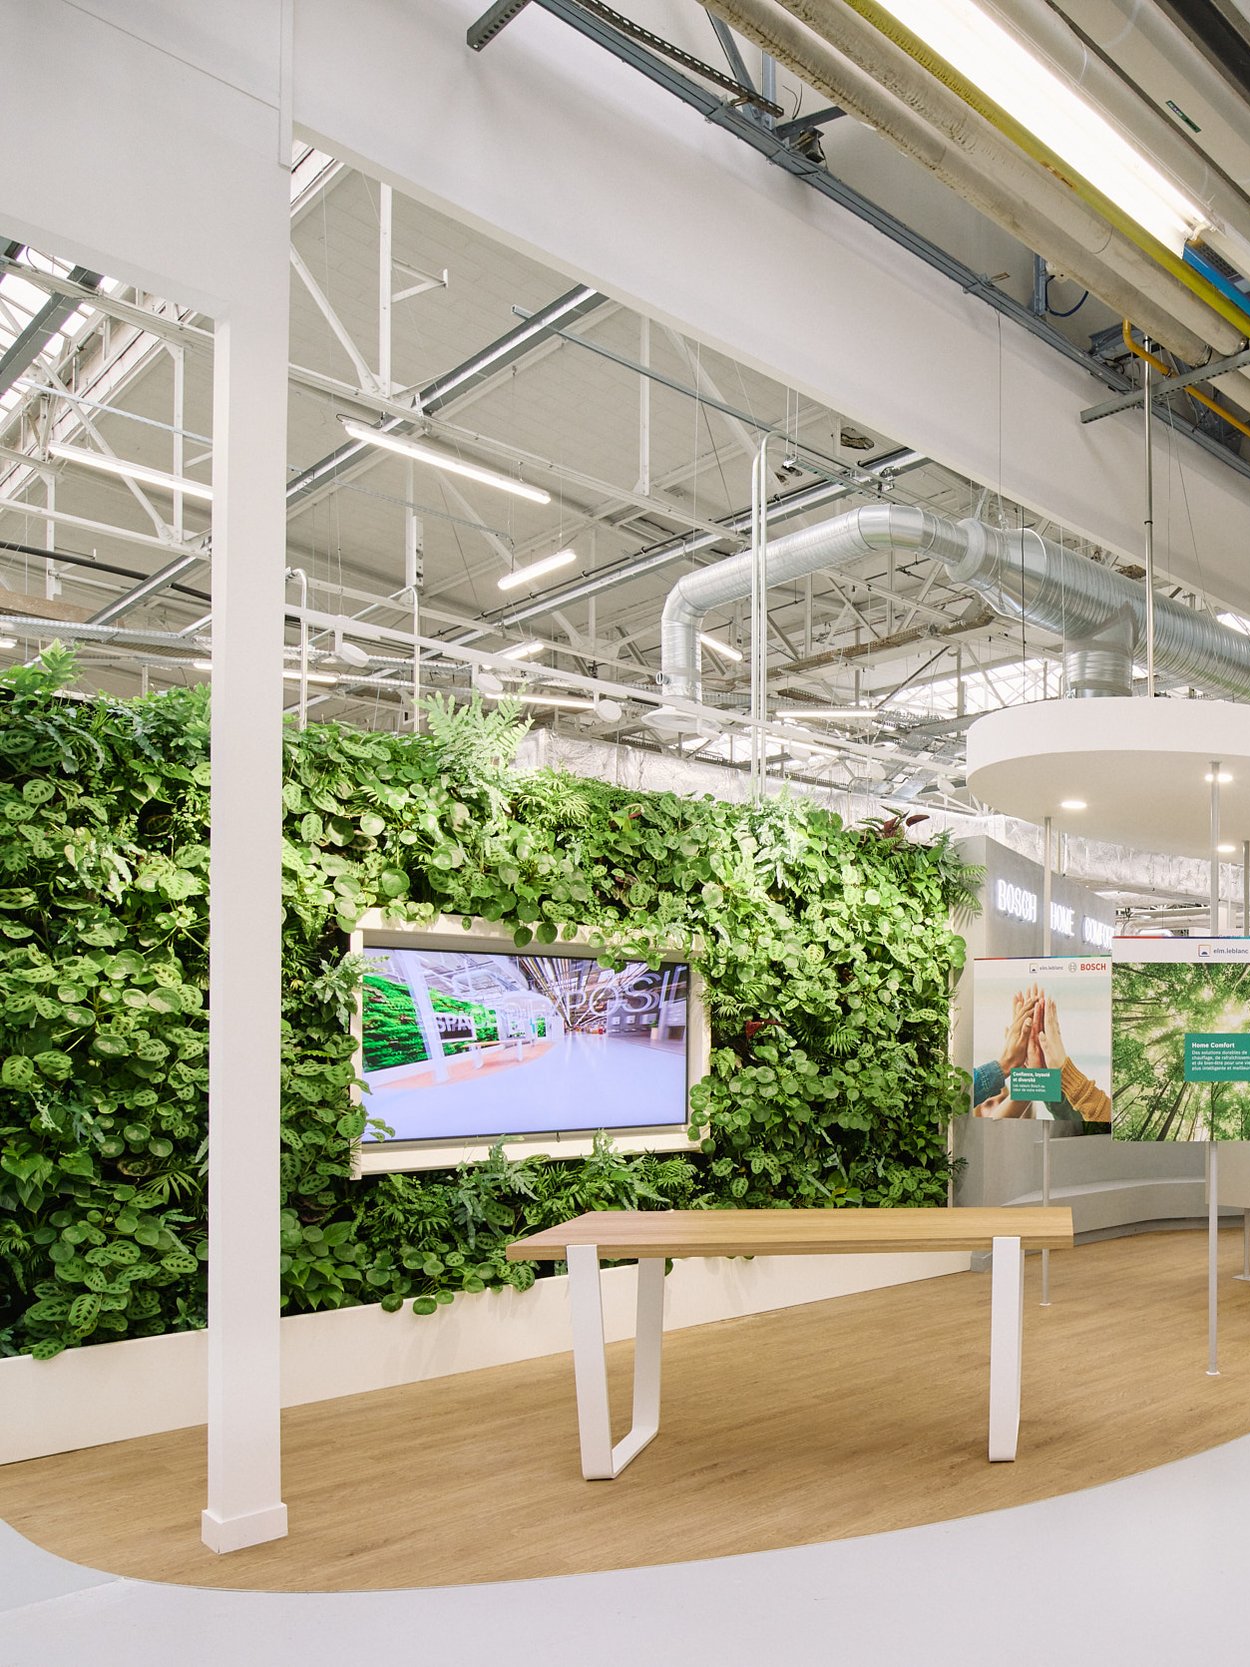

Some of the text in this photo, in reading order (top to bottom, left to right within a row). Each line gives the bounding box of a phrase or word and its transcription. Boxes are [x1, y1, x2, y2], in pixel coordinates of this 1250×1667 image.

[997, 879, 1037, 923] BOSCH
[1050, 901, 1075, 936] HOME
[1213, 947, 1249, 955] elm.leblanc
[1080, 963, 1107, 971] BOSCH
